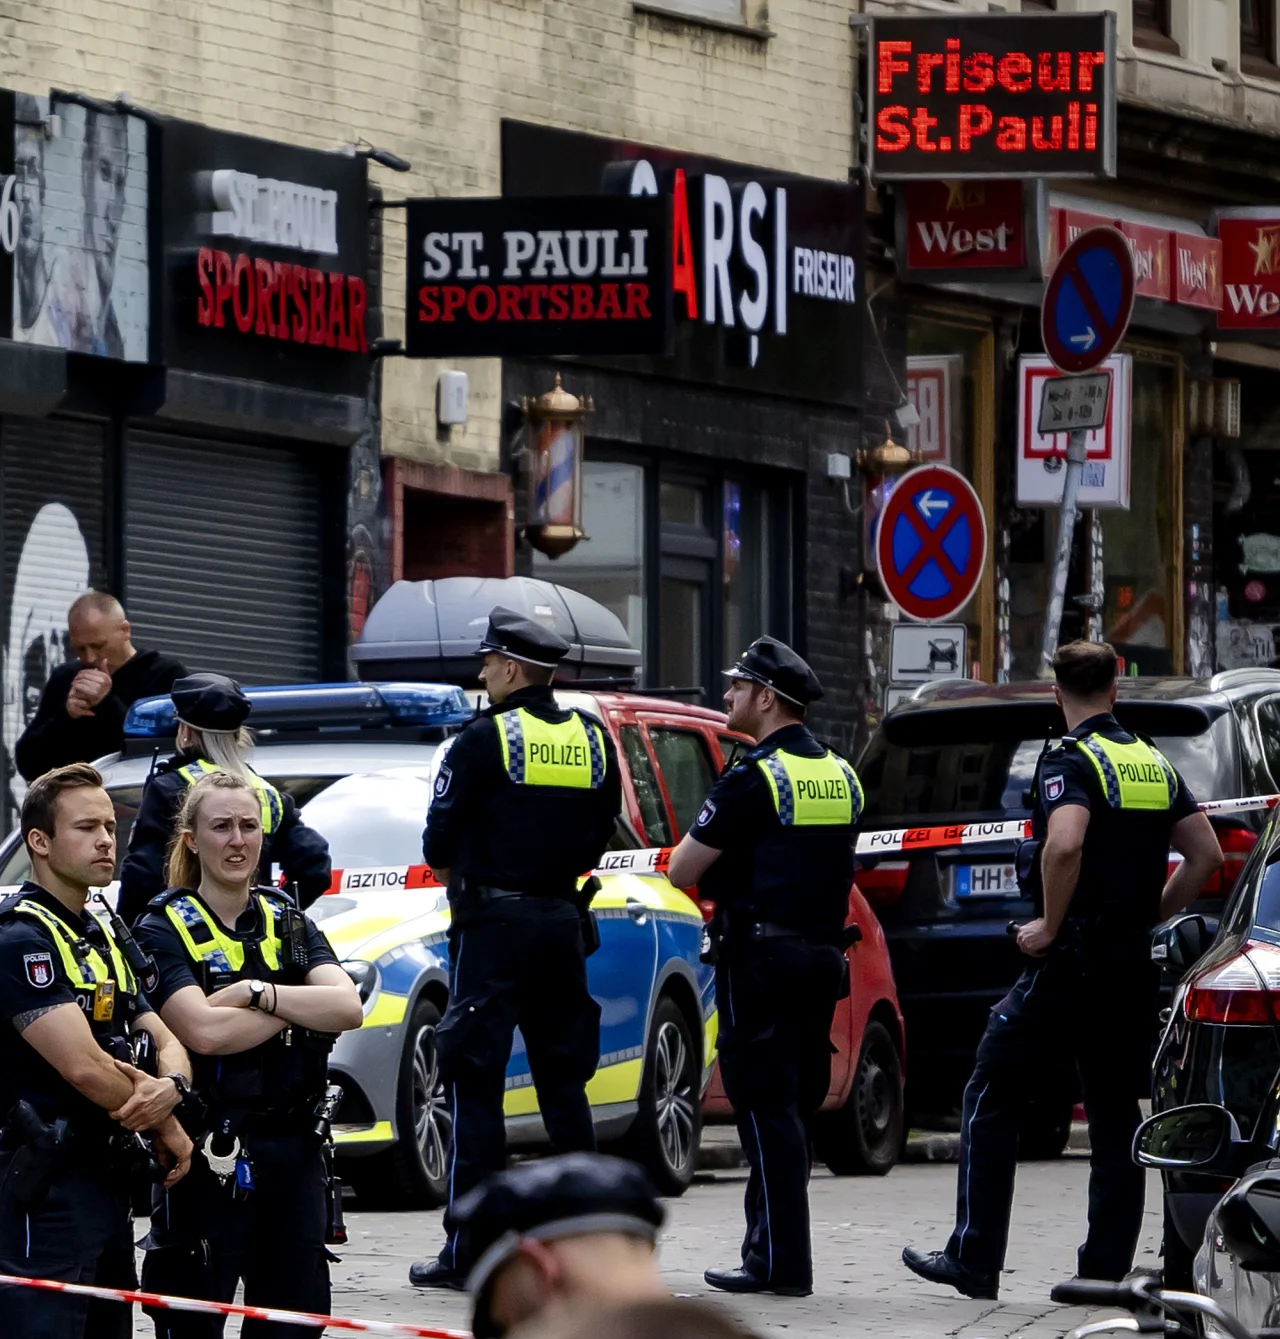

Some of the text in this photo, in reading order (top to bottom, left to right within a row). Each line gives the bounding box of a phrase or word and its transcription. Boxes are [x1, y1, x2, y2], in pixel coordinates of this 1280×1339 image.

[876, 37, 1106, 96] Friseur
[916, 219, 1014, 254] West
[423, 229, 650, 280] ST. PAULI
[1132, 236, 1155, 281] est
[1177, 247, 1209, 292] West
[792, 245, 857, 305] FRISEUR
[197, 246, 369, 354] SPORTSBAR
[417, 282, 652, 324] SPORTSBAR
[529, 743, 588, 768] POLIZEI
[1116, 762, 1166, 784] POLIZEI
[797, 778, 849, 801] POLIZEI
[870, 828, 932, 847] POLIZEI
[346, 869, 408, 890] POLIZEI
[595, 853, 636, 871] LIZEI
[972, 868, 1002, 892] HH
